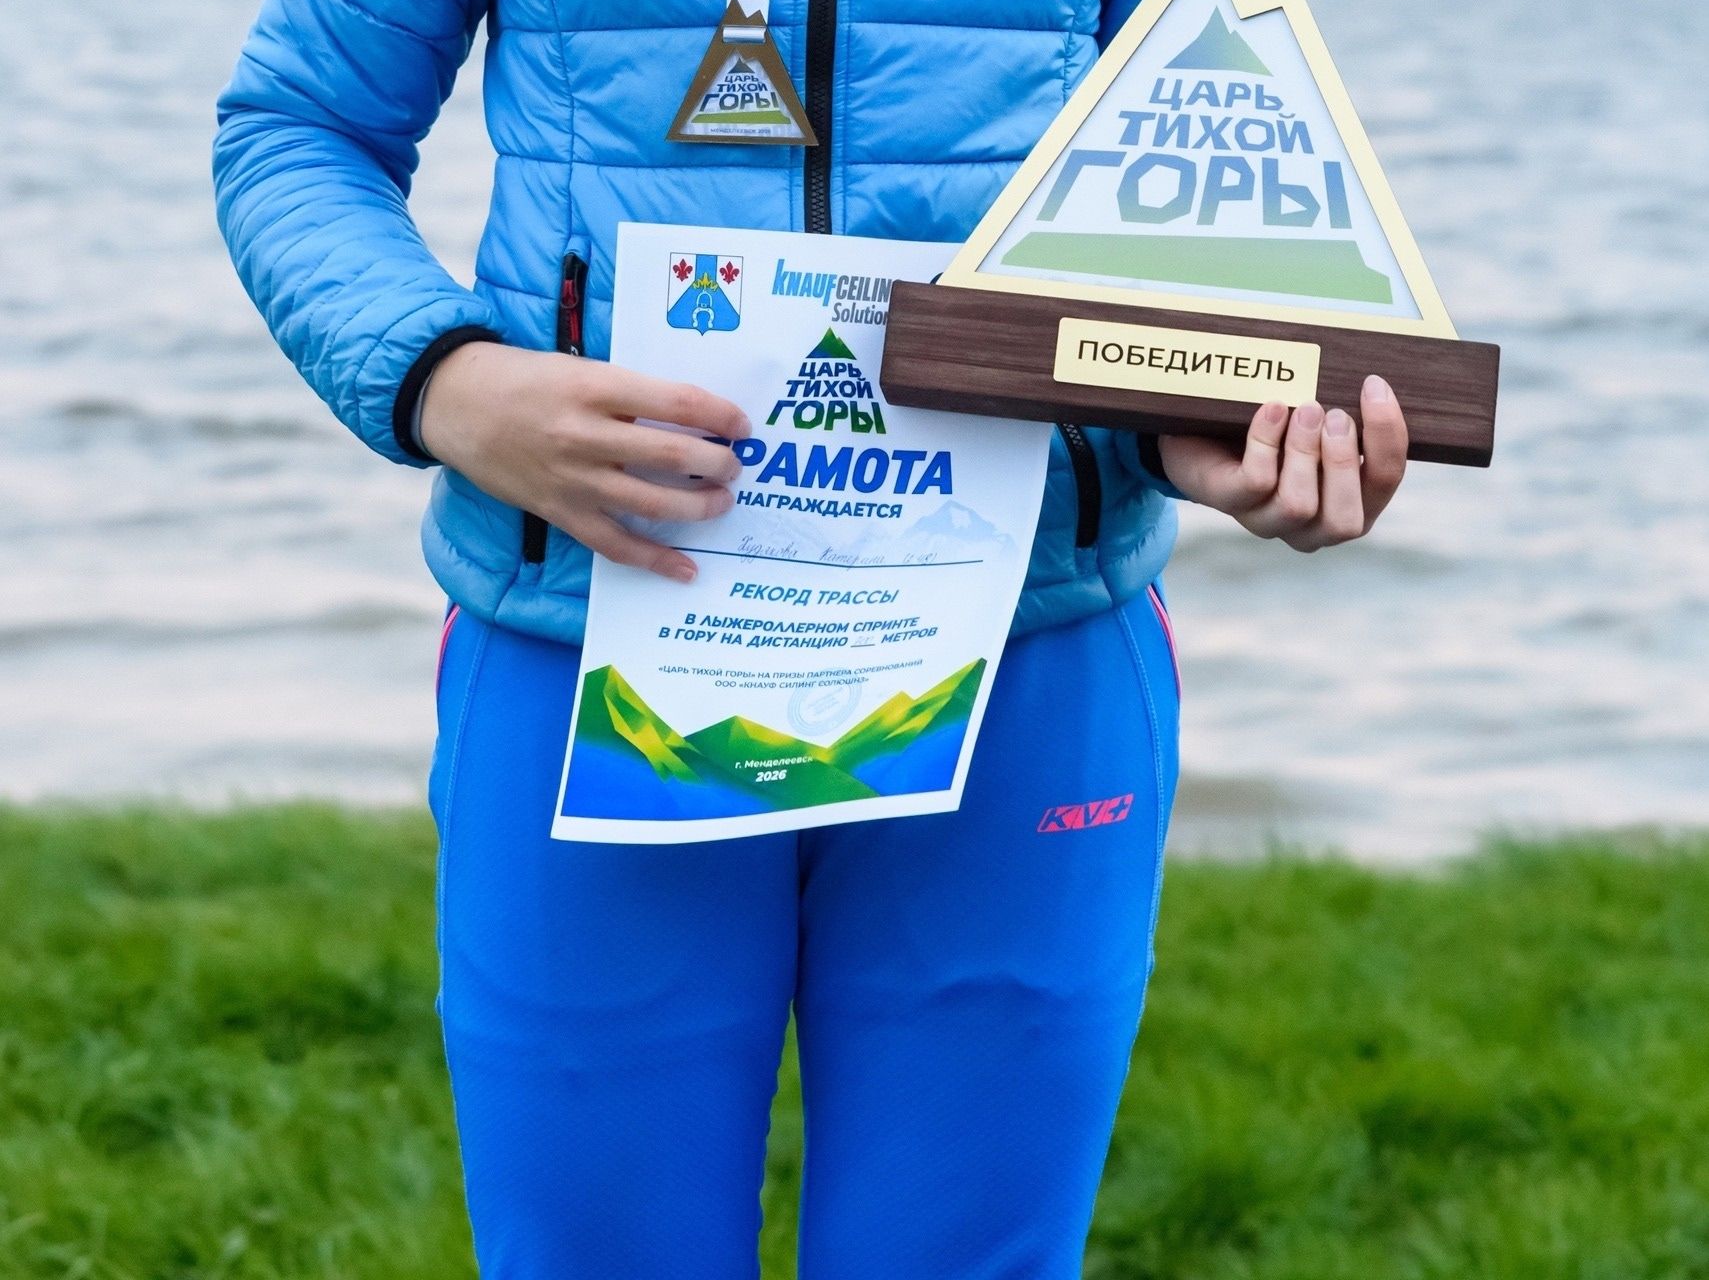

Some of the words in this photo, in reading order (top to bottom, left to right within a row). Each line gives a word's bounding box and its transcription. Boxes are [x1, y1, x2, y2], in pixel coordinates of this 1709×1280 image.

[716, 82, 768, 93] ТИХОЙ
[724, 75, 760, 84] ЦАРЬ
[699, 91, 780, 112] ГОРЫ
[1148, 77, 1285, 112] ЦАРЬ
[1117, 110, 1315, 155] ТИХОЙ
[1035, 148, 1353, 230] ГОРЫ
[835, 274, 893, 303] CEILIN
[798, 361, 862, 380] ЦАРЬ
[1077, 339, 1296, 383] ПОБЕДИТЕЛЬ
[786, 377, 874, 399] ТИХОЙ
[765, 399, 887, 435] ГОРЫ
[690, 436, 953, 495] РАМОТА
[736, 489, 903, 519] НАГРАЖДАЕТСЯ
[729, 582, 813, 607] РЕКОРД
[817, 589, 900, 606] ТРАССЫ
[684, 613, 697, 625] В
[699, 615, 850, 634] ЛЫЖЕРОЛЛЕРНОМ
[852, 616, 921, 633] СПРИНТЕ
[658, 626, 671, 638] В
[674, 628, 717, 642] ГОРУ
[720, 632, 742, 645] НА
[745, 635, 849, 649] ДИСТАНЦИЮ
[880, 626, 939, 644] МЕТРОВ
[658, 664, 689, 674] «ЦАРЬ
[691, 667, 723, 677] ТИХОЙ
[757, 671, 770, 679] НА
[772, 671, 805, 679] ПРИЗЫ
[806, 669, 852, 678] ПАРТНЕРА
[853, 658, 923, 675] СОРЕВНОВАНИЙ
[714, 679, 737, 688] ООО
[739, 681, 777, 689] «КНАУФ
[779, 680, 816, 689] СИЛИНГ
[734, 761, 742, 769] г.
[744, 755, 814, 769] Менделеевск
[755, 769, 788, 783] 2026
